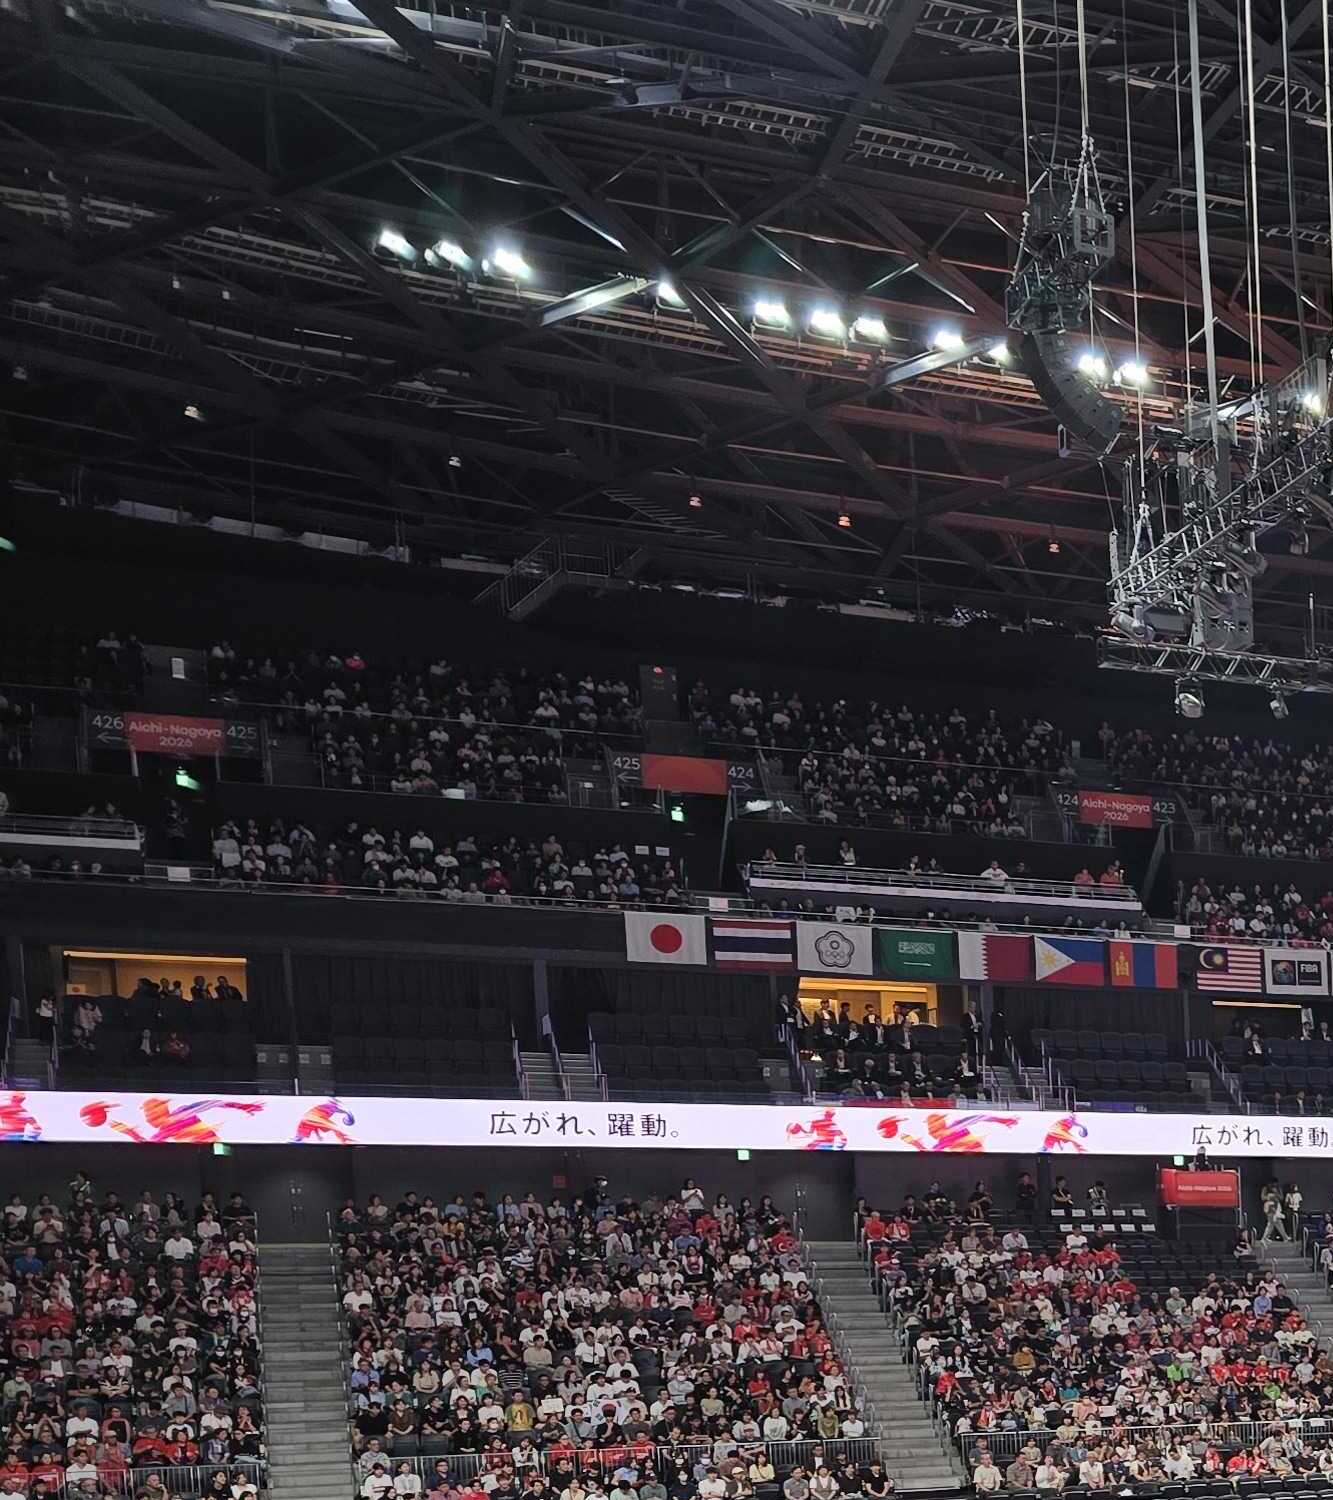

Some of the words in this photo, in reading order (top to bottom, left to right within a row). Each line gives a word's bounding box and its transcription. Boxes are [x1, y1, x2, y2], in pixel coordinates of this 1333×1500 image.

[93, 714, 124, 731] 426
[129, 720, 222, 740] Aichi-Nagoya
[227, 725, 257, 740] 425
[159, 734, 193, 748] 2026
[614, 756, 641, 771] 425
[728, 765, 755, 780] 424
[1082, 797, 1151, 815] Aichi-Nagoya
[1153, 801, 1177, 815] 423
[1103, 810, 1129, 823] 2026
[1300, 963, 1320, 974] FIBA
[490, 1110, 680, 1139] 広がれ、躍動。
